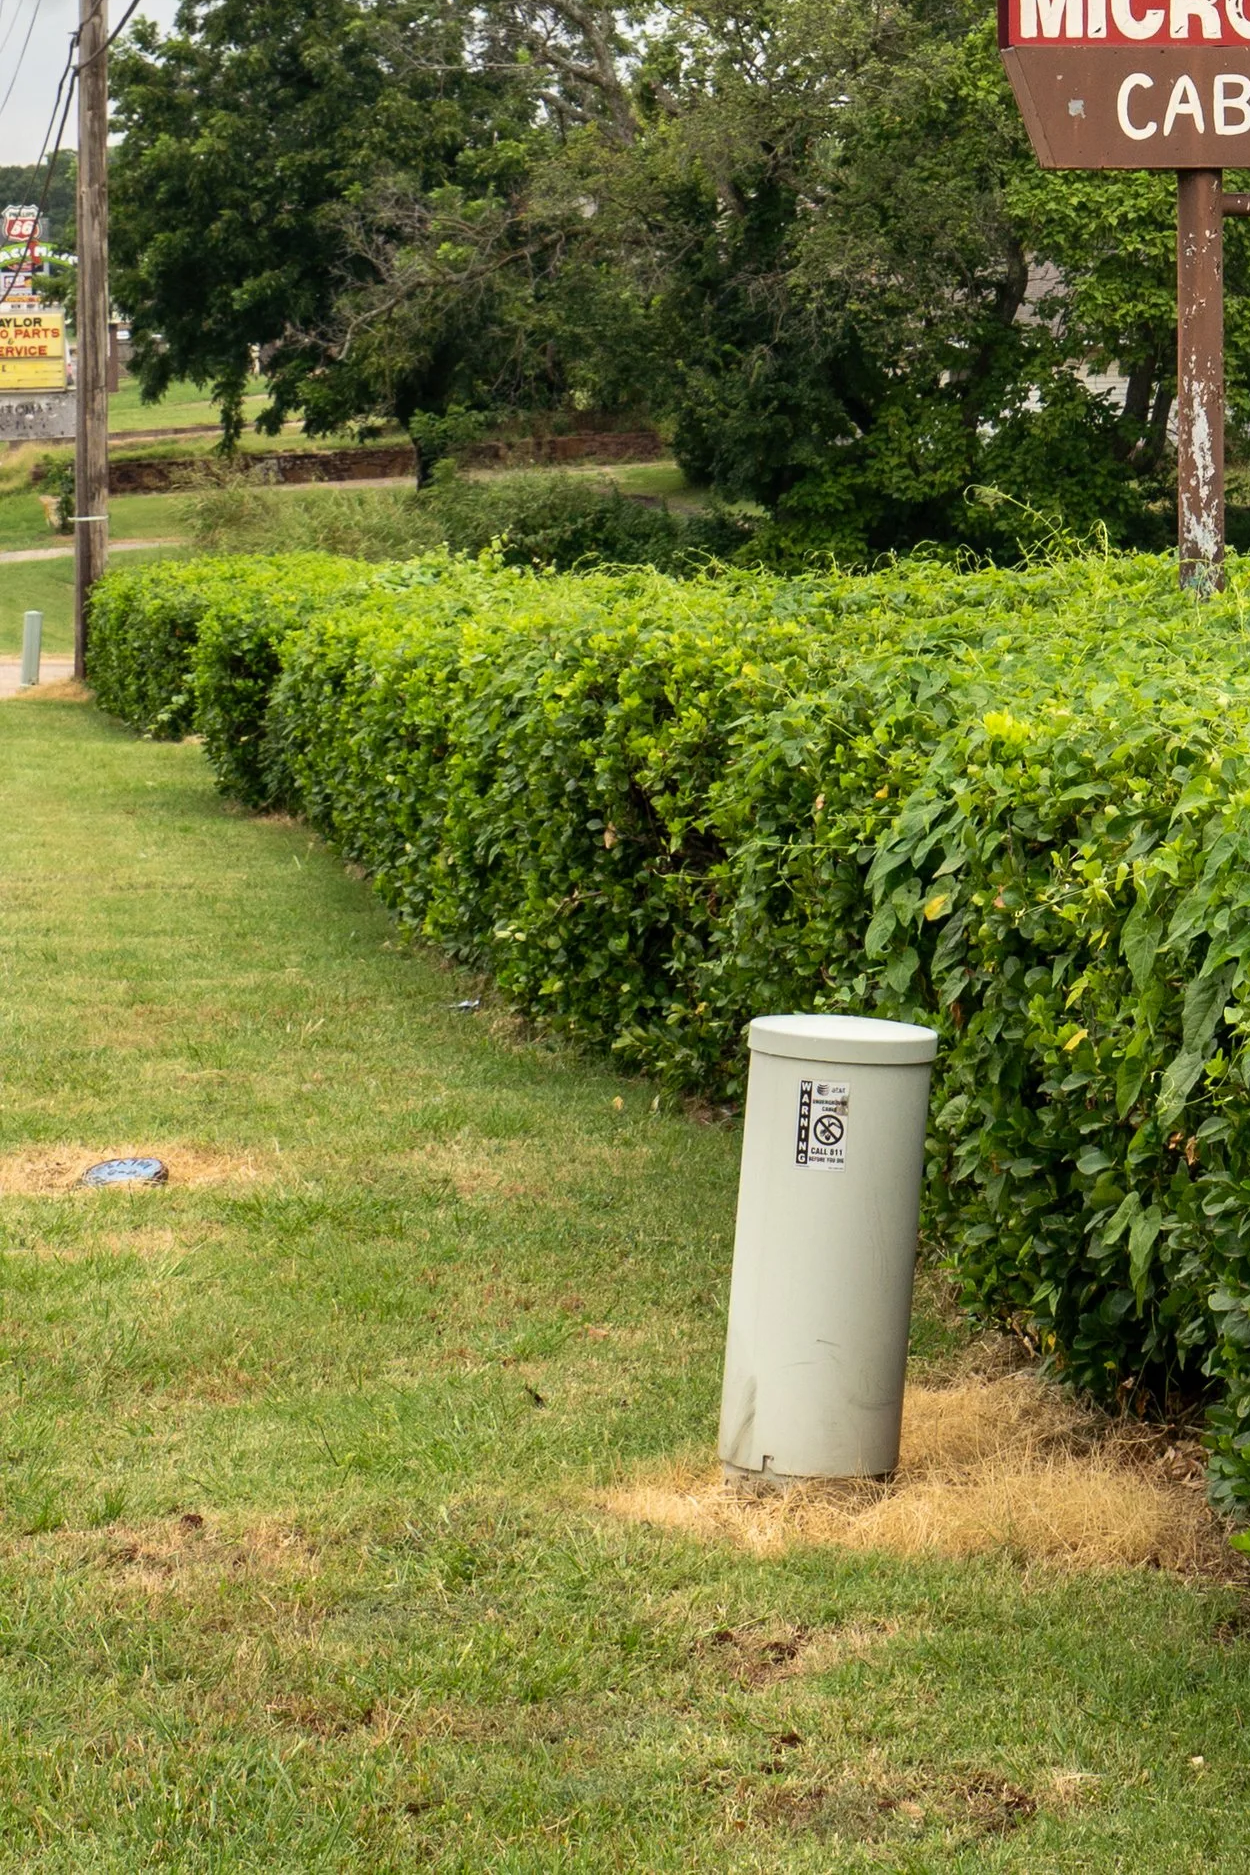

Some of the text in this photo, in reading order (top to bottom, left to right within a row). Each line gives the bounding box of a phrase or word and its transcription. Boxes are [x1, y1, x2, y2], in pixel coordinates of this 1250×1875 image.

[10, 220, 35, 236] 66
[14, 328, 61, 339] PARTS
[798, 1082, 811, 1162] WARNING
[811, 1147, 843, 1156] CALL 811
